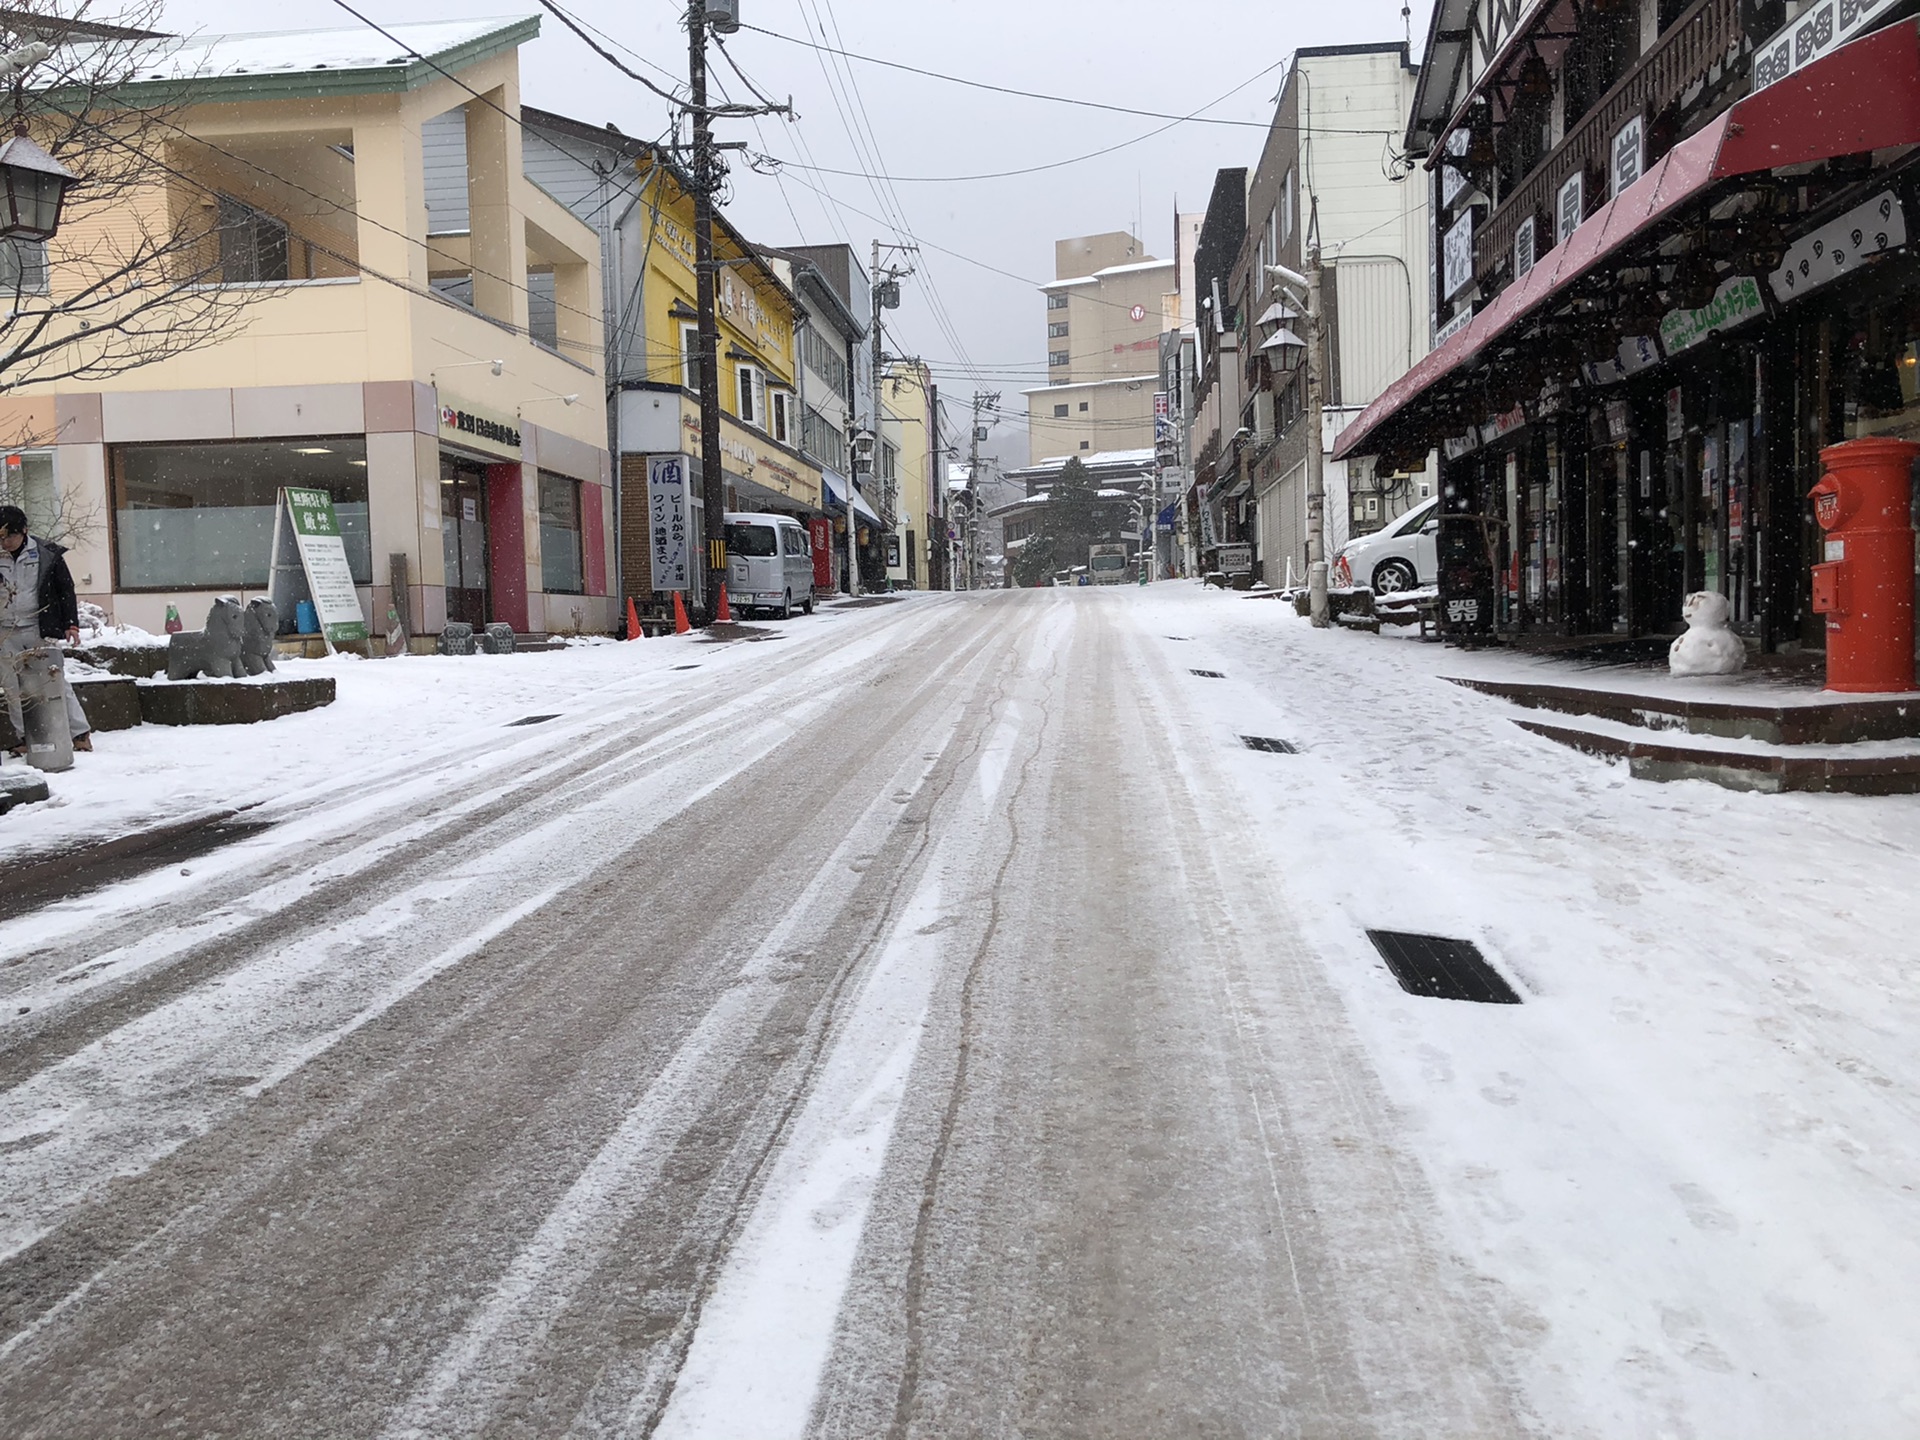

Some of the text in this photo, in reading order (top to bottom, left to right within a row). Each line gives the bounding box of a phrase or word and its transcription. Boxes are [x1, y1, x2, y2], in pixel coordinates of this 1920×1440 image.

[652, 459, 682, 486] 酒
[670, 493, 685, 542] ビールから
[1820, 510, 1834, 520] POST
[1447, 599, 1479, 623] 器
